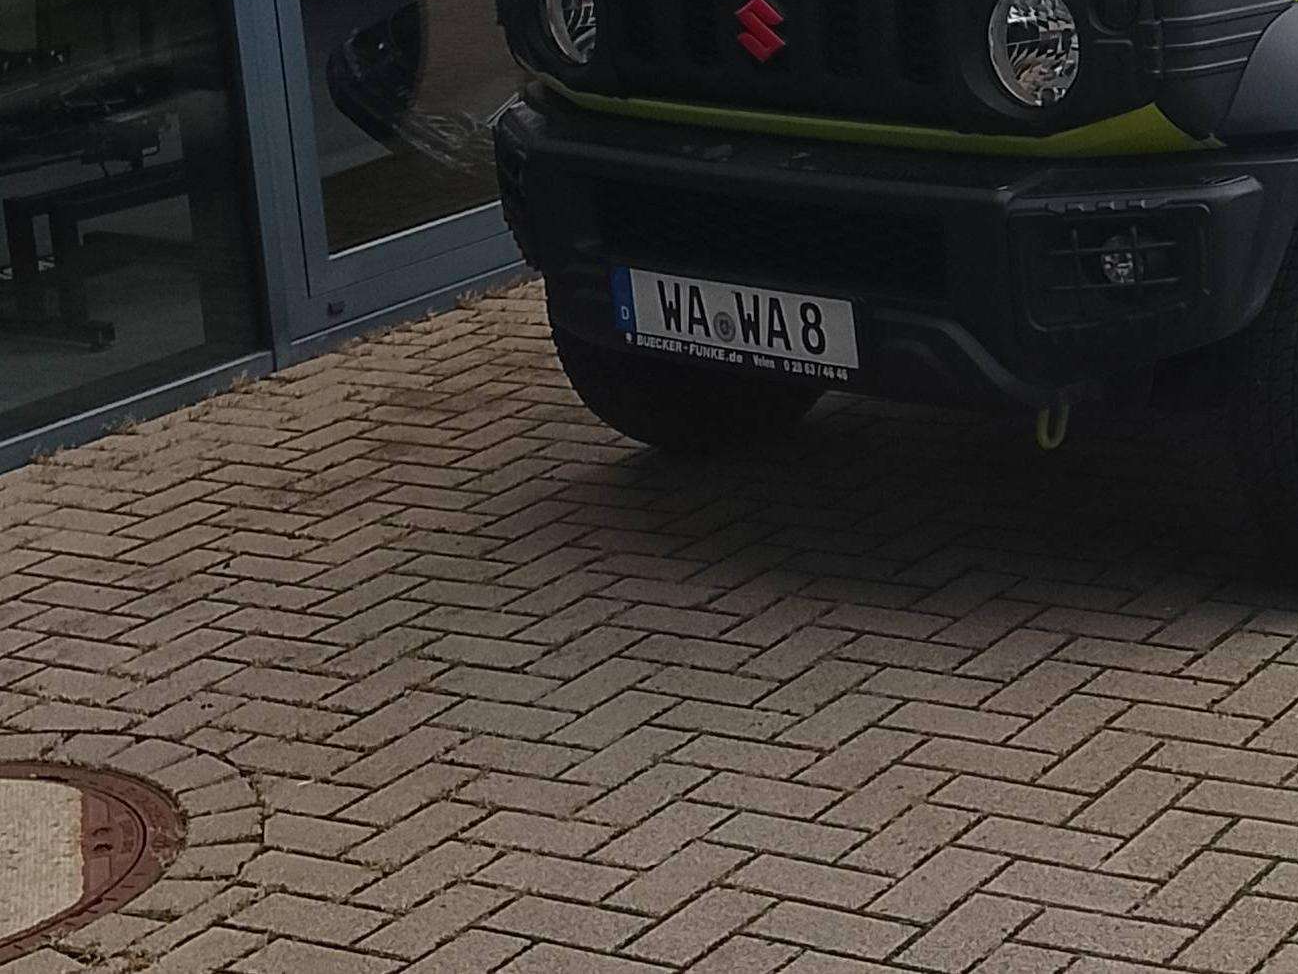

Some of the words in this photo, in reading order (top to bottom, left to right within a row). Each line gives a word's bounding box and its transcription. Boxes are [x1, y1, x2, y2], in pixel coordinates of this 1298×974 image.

[657, 280, 711, 338] WA
[734, 291, 792, 352] WA
[800, 301, 826, 356] 8
